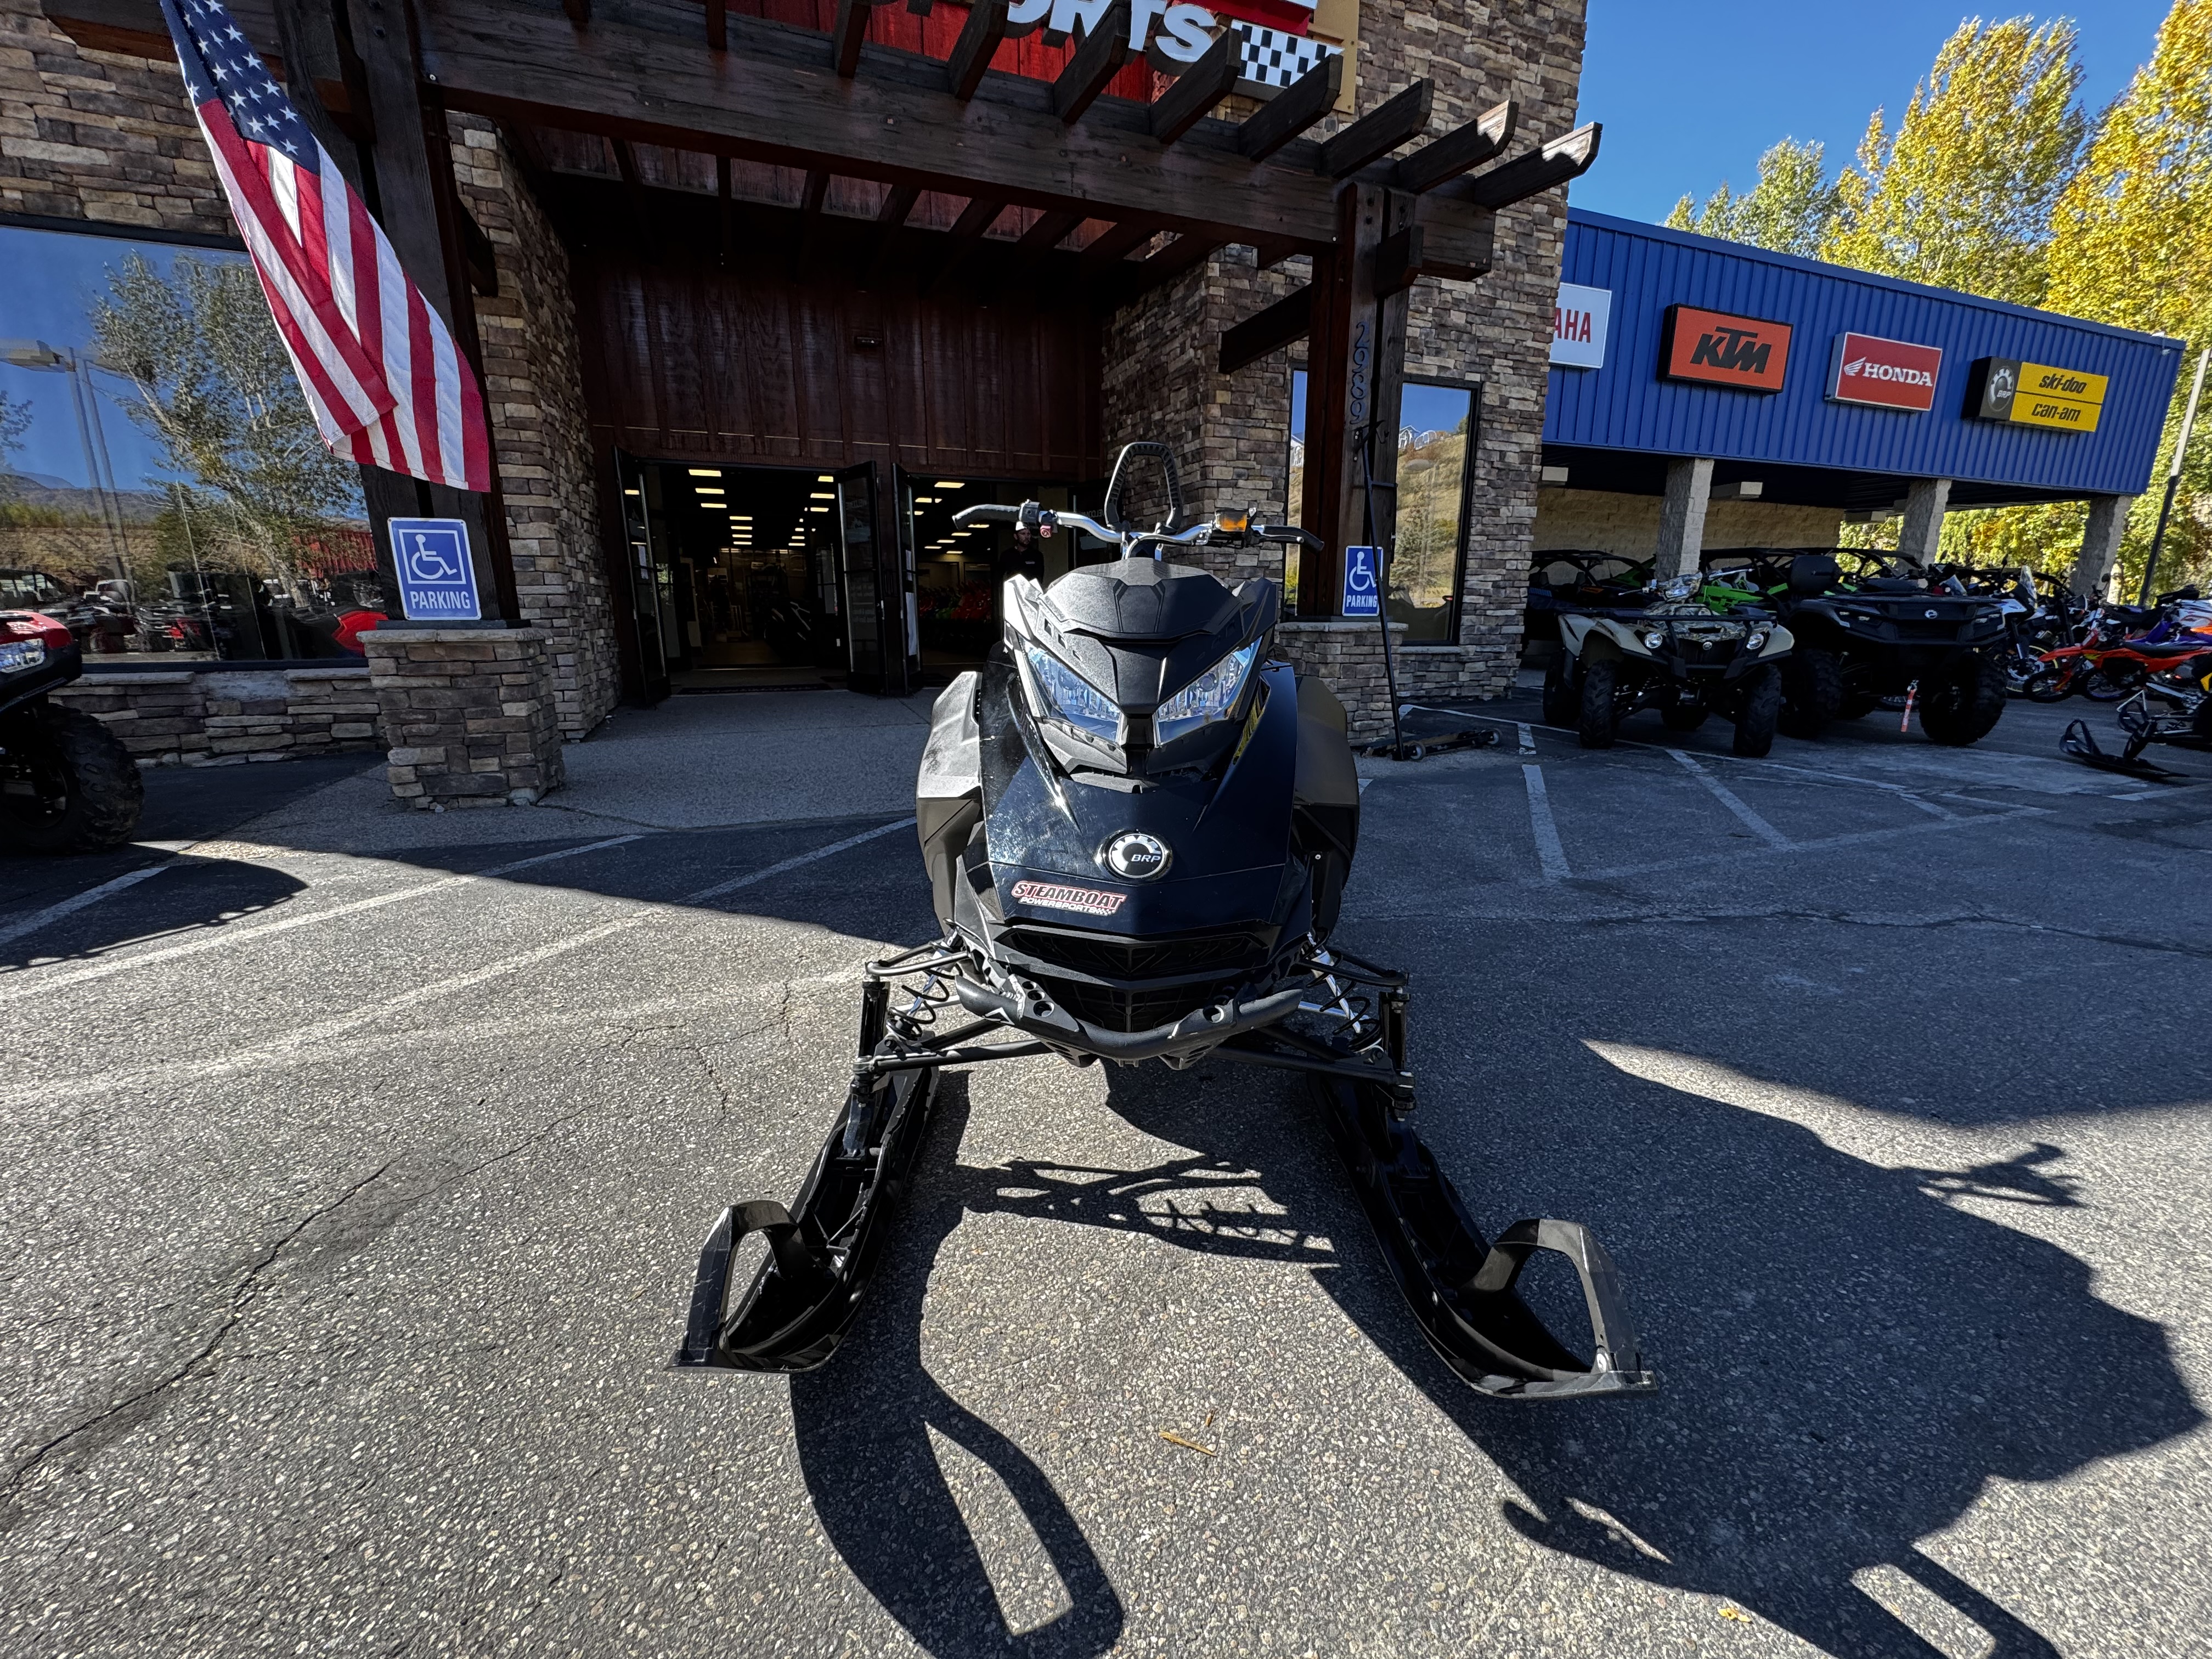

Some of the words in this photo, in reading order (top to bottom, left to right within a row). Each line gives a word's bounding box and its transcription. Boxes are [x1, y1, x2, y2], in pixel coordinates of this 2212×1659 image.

[1690, 326, 1772, 374] KTM
[1863, 362, 1933, 387] HONDA
[2039, 373, 2087, 394] ski-doo
[1996, 390, 2012, 399] BRP
[2032, 403, 2081, 422] can-am
[409, 591, 471, 609] PARKING
[1346, 595, 1378, 608] PARKING
[1131, 854, 1161, 863] BRP
[1014, 883, 1125, 909] STEAMBOAT
[1020, 896, 1098, 913] POWERSPORTS
